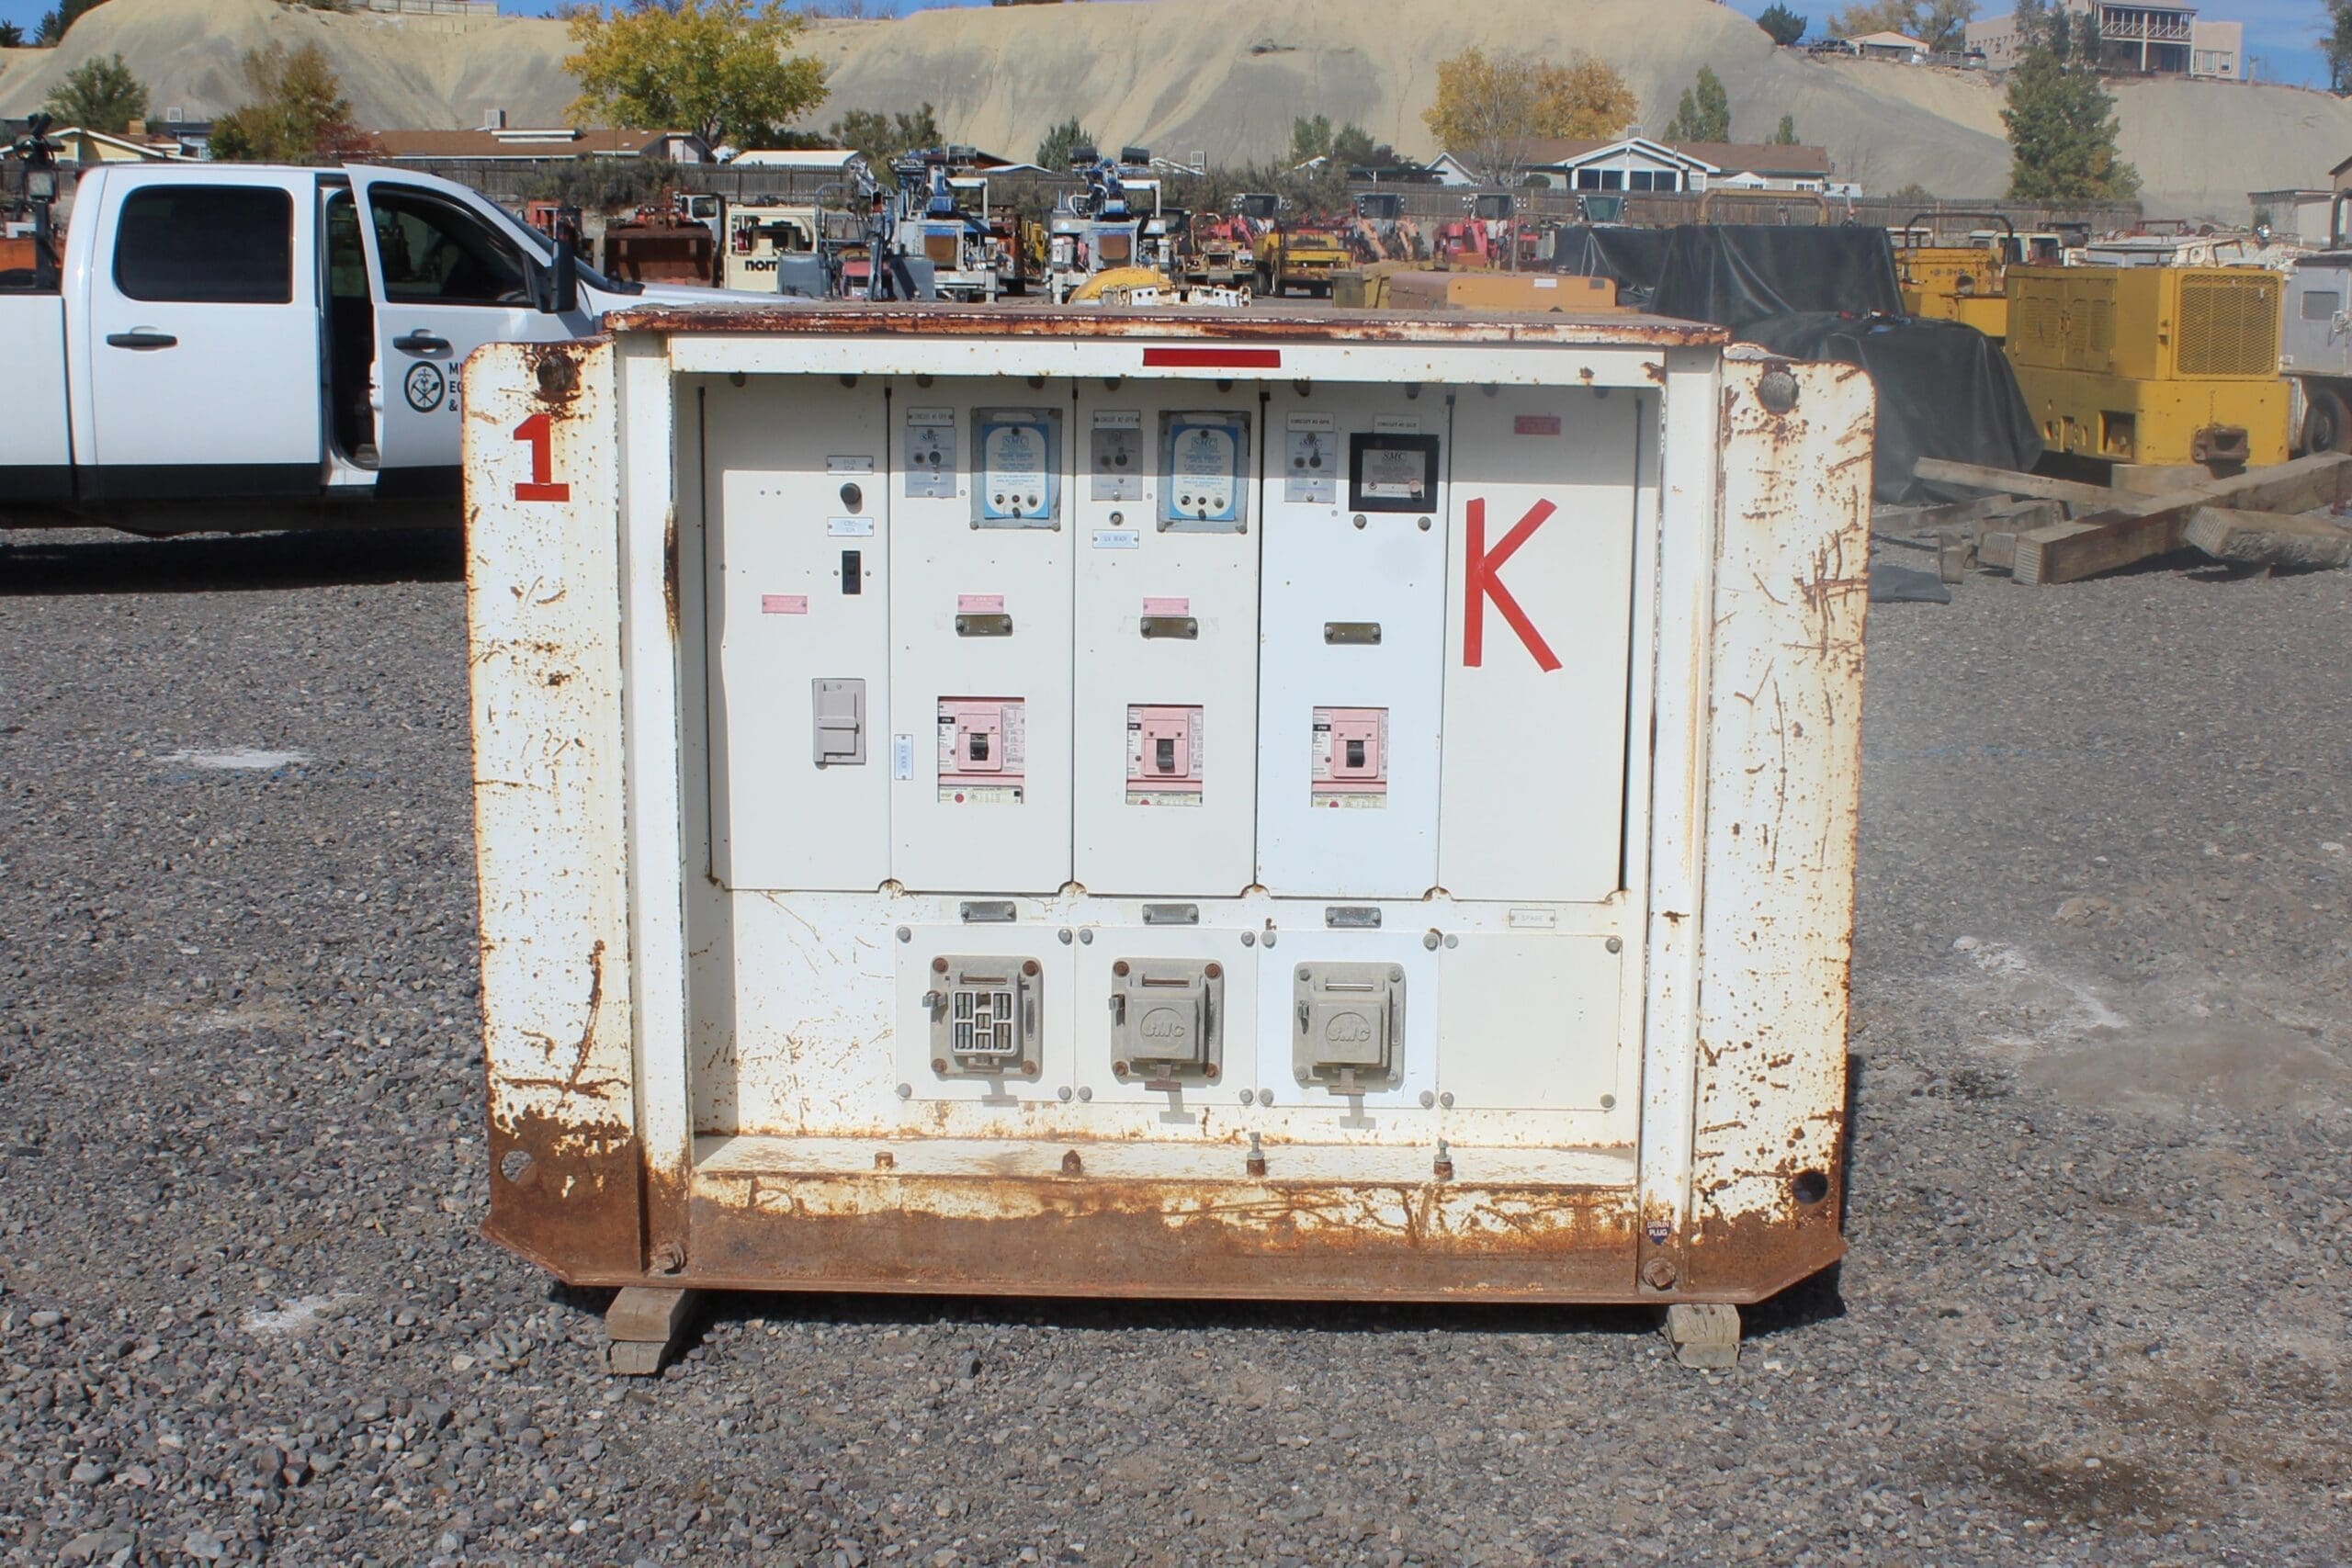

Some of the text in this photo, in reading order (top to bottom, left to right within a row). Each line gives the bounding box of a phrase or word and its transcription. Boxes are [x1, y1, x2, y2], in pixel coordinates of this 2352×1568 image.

[448, 399, 458, 412] &
[513, 413, 570, 502] 1
[1464, 497, 1564, 672] K
